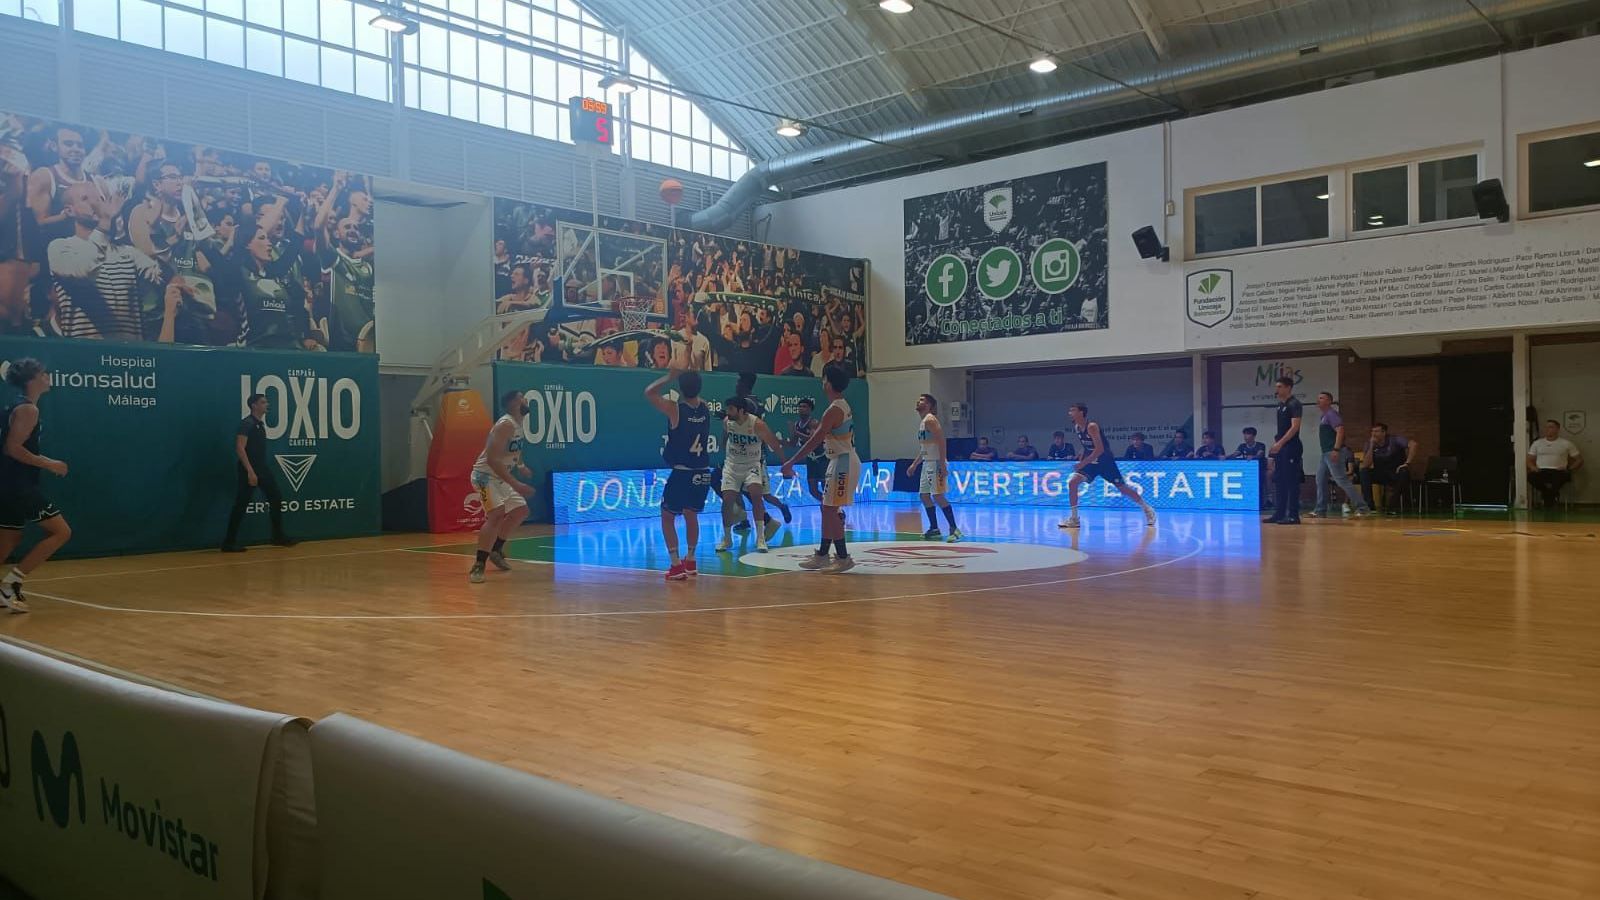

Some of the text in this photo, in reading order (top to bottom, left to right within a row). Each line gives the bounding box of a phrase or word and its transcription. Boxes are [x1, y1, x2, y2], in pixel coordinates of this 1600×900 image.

[595, 117, 609, 142] 5
[942, 311, 1031, 336] Conectados
[1049, 306, 1063, 326] ti
[101, 355, 156, 369] Hospital
[288, 369, 316, 377] CAMPAÑA
[108, 394, 157, 408] Málaga
[689, 433, 703, 457] 4
[1103, 471, 1243, 499] ESTATE
[304, 498, 355, 511] ESTATE
[100, 777, 218, 881] Movistar
